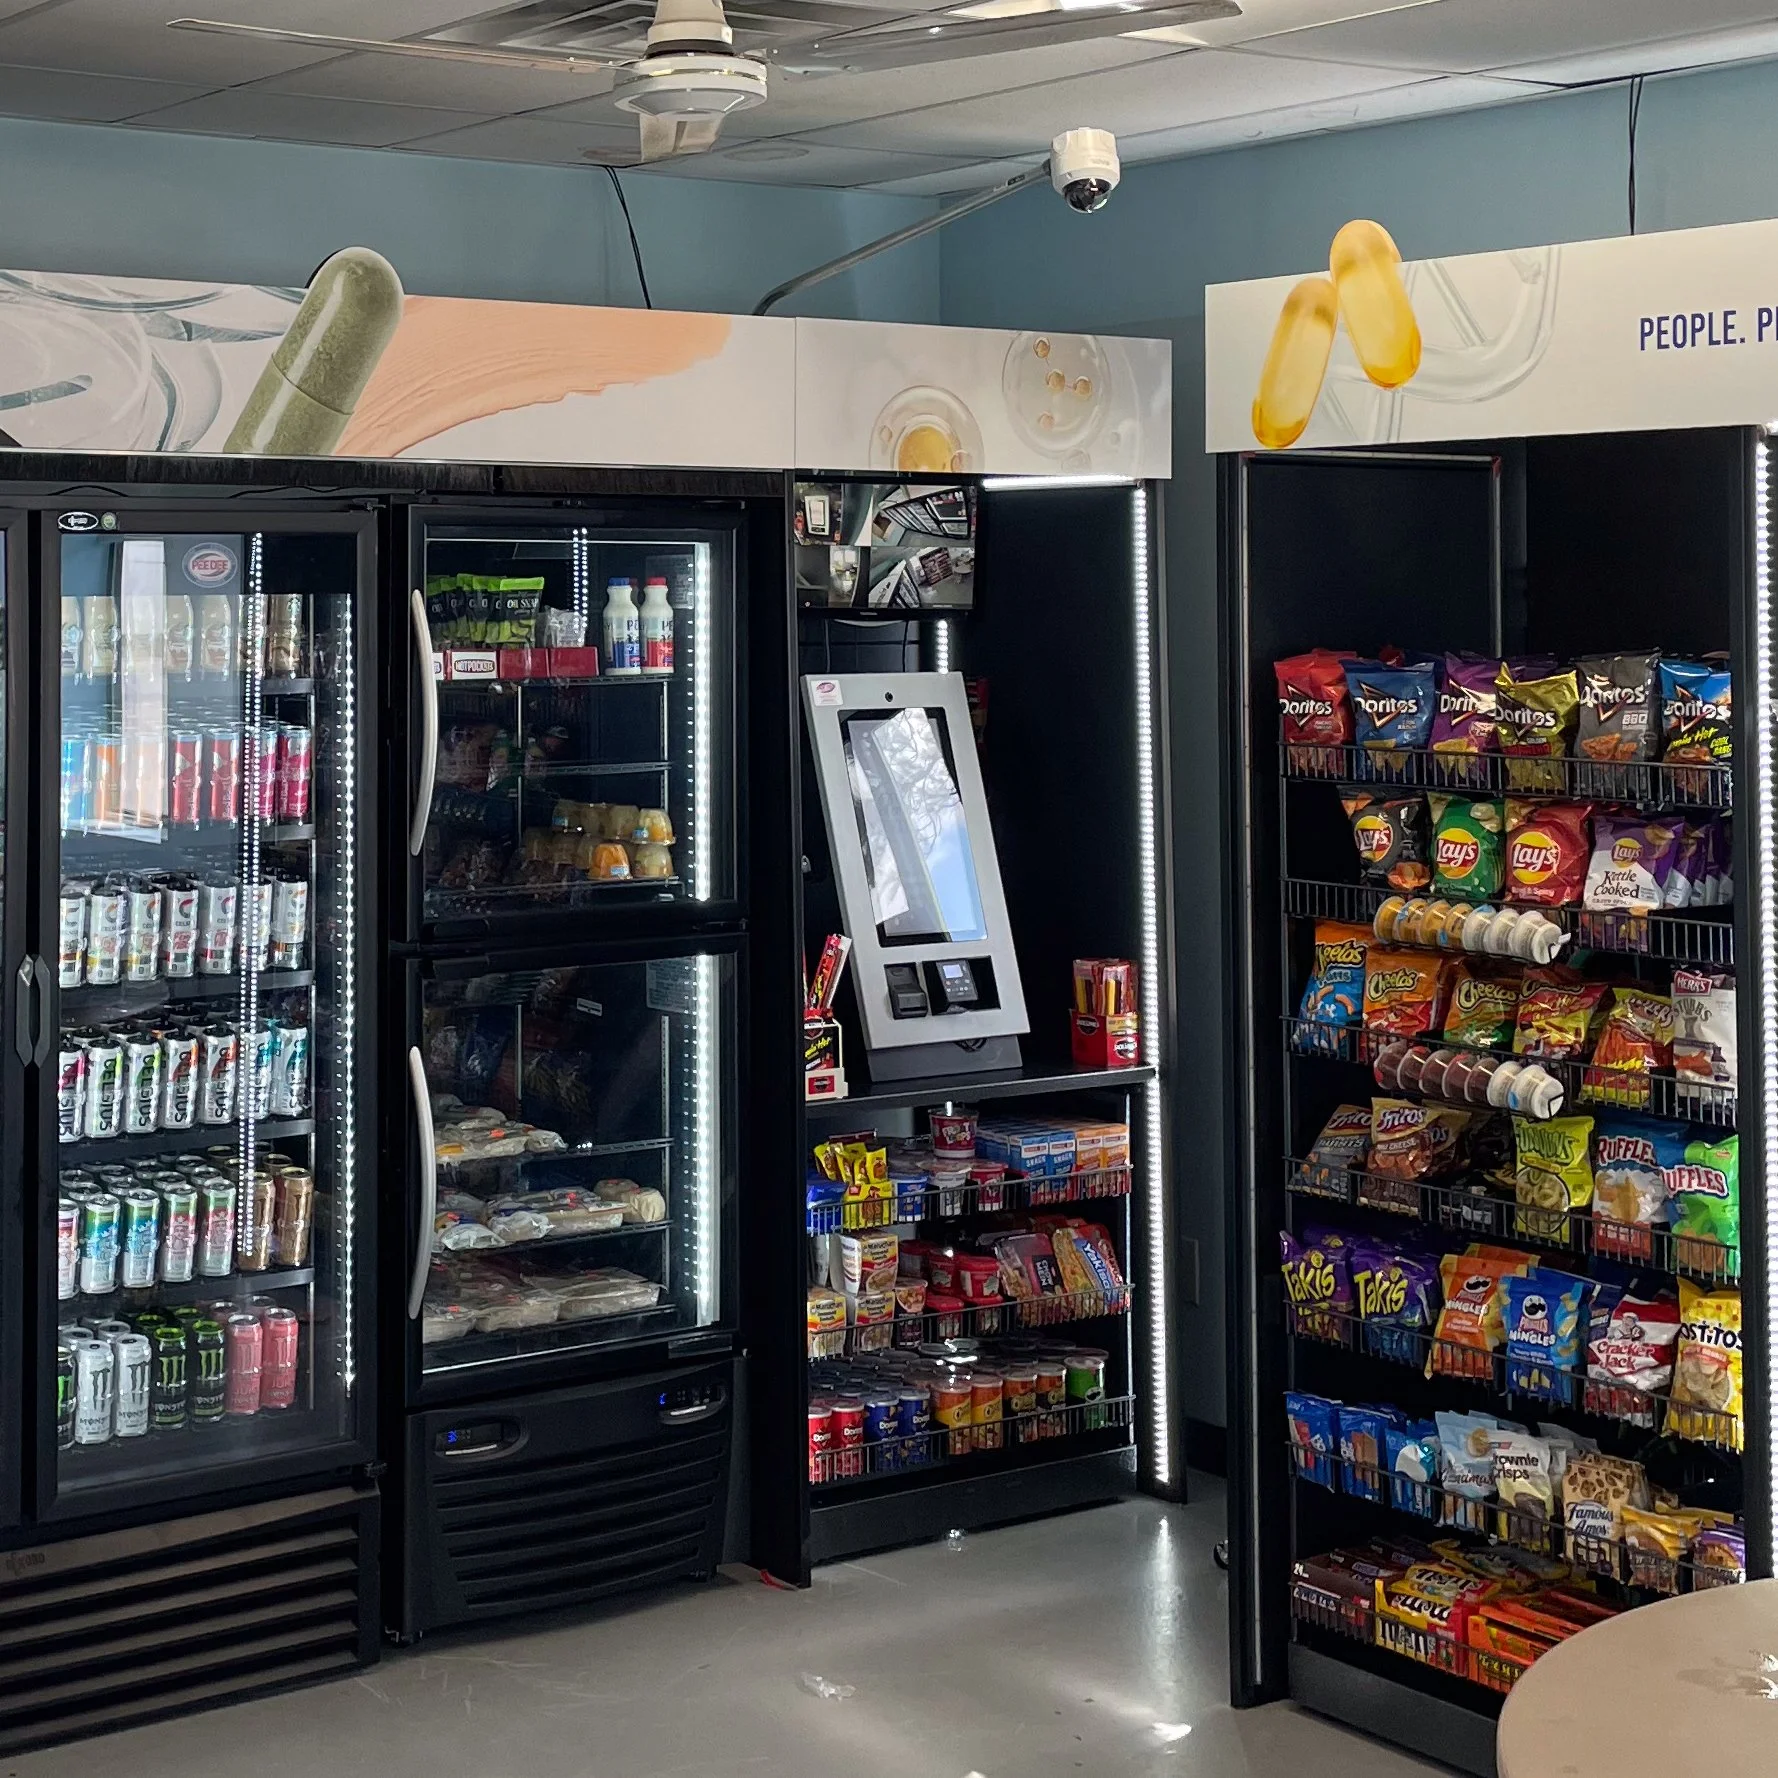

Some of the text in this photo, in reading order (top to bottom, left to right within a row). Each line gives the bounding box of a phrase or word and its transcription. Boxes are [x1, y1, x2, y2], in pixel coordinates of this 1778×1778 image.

[1640, 310, 1746, 351] PEOPLE.
[1278, 697, 1333, 716] Doritos
[1353, 696, 1418, 714] Doritos
[1580, 683, 1645, 708] Doritos
[1622, 713, 1648, 725] BBQ
[1663, 699, 1732, 721] Doritos
[1357, 827, 1390, 852] Lay's
[1436, 840, 1478, 868] Lay's
[1513, 842, 1560, 871] Lay's
[1613, 844, 1642, 863] Lay's
[1601, 869, 1638, 886] Kettle
[1593, 881, 1641, 898] Cooked
[1367, 968, 1418, 1002] Cheetos
[1674, 997, 1713, 1022] STUBB'S
[1377, 1108, 1428, 1131] Fritos
[1281, 1260, 1335, 1302] Takis
[1354, 1269, 1409, 1319] Takis
[1508, 1329, 1557, 1346] MINGLES
[1597, 1341, 1655, 1357] Cracker
[1600, 1354, 1636, 1370] Jack
[1567, 1502, 1614, 1522] Famous
